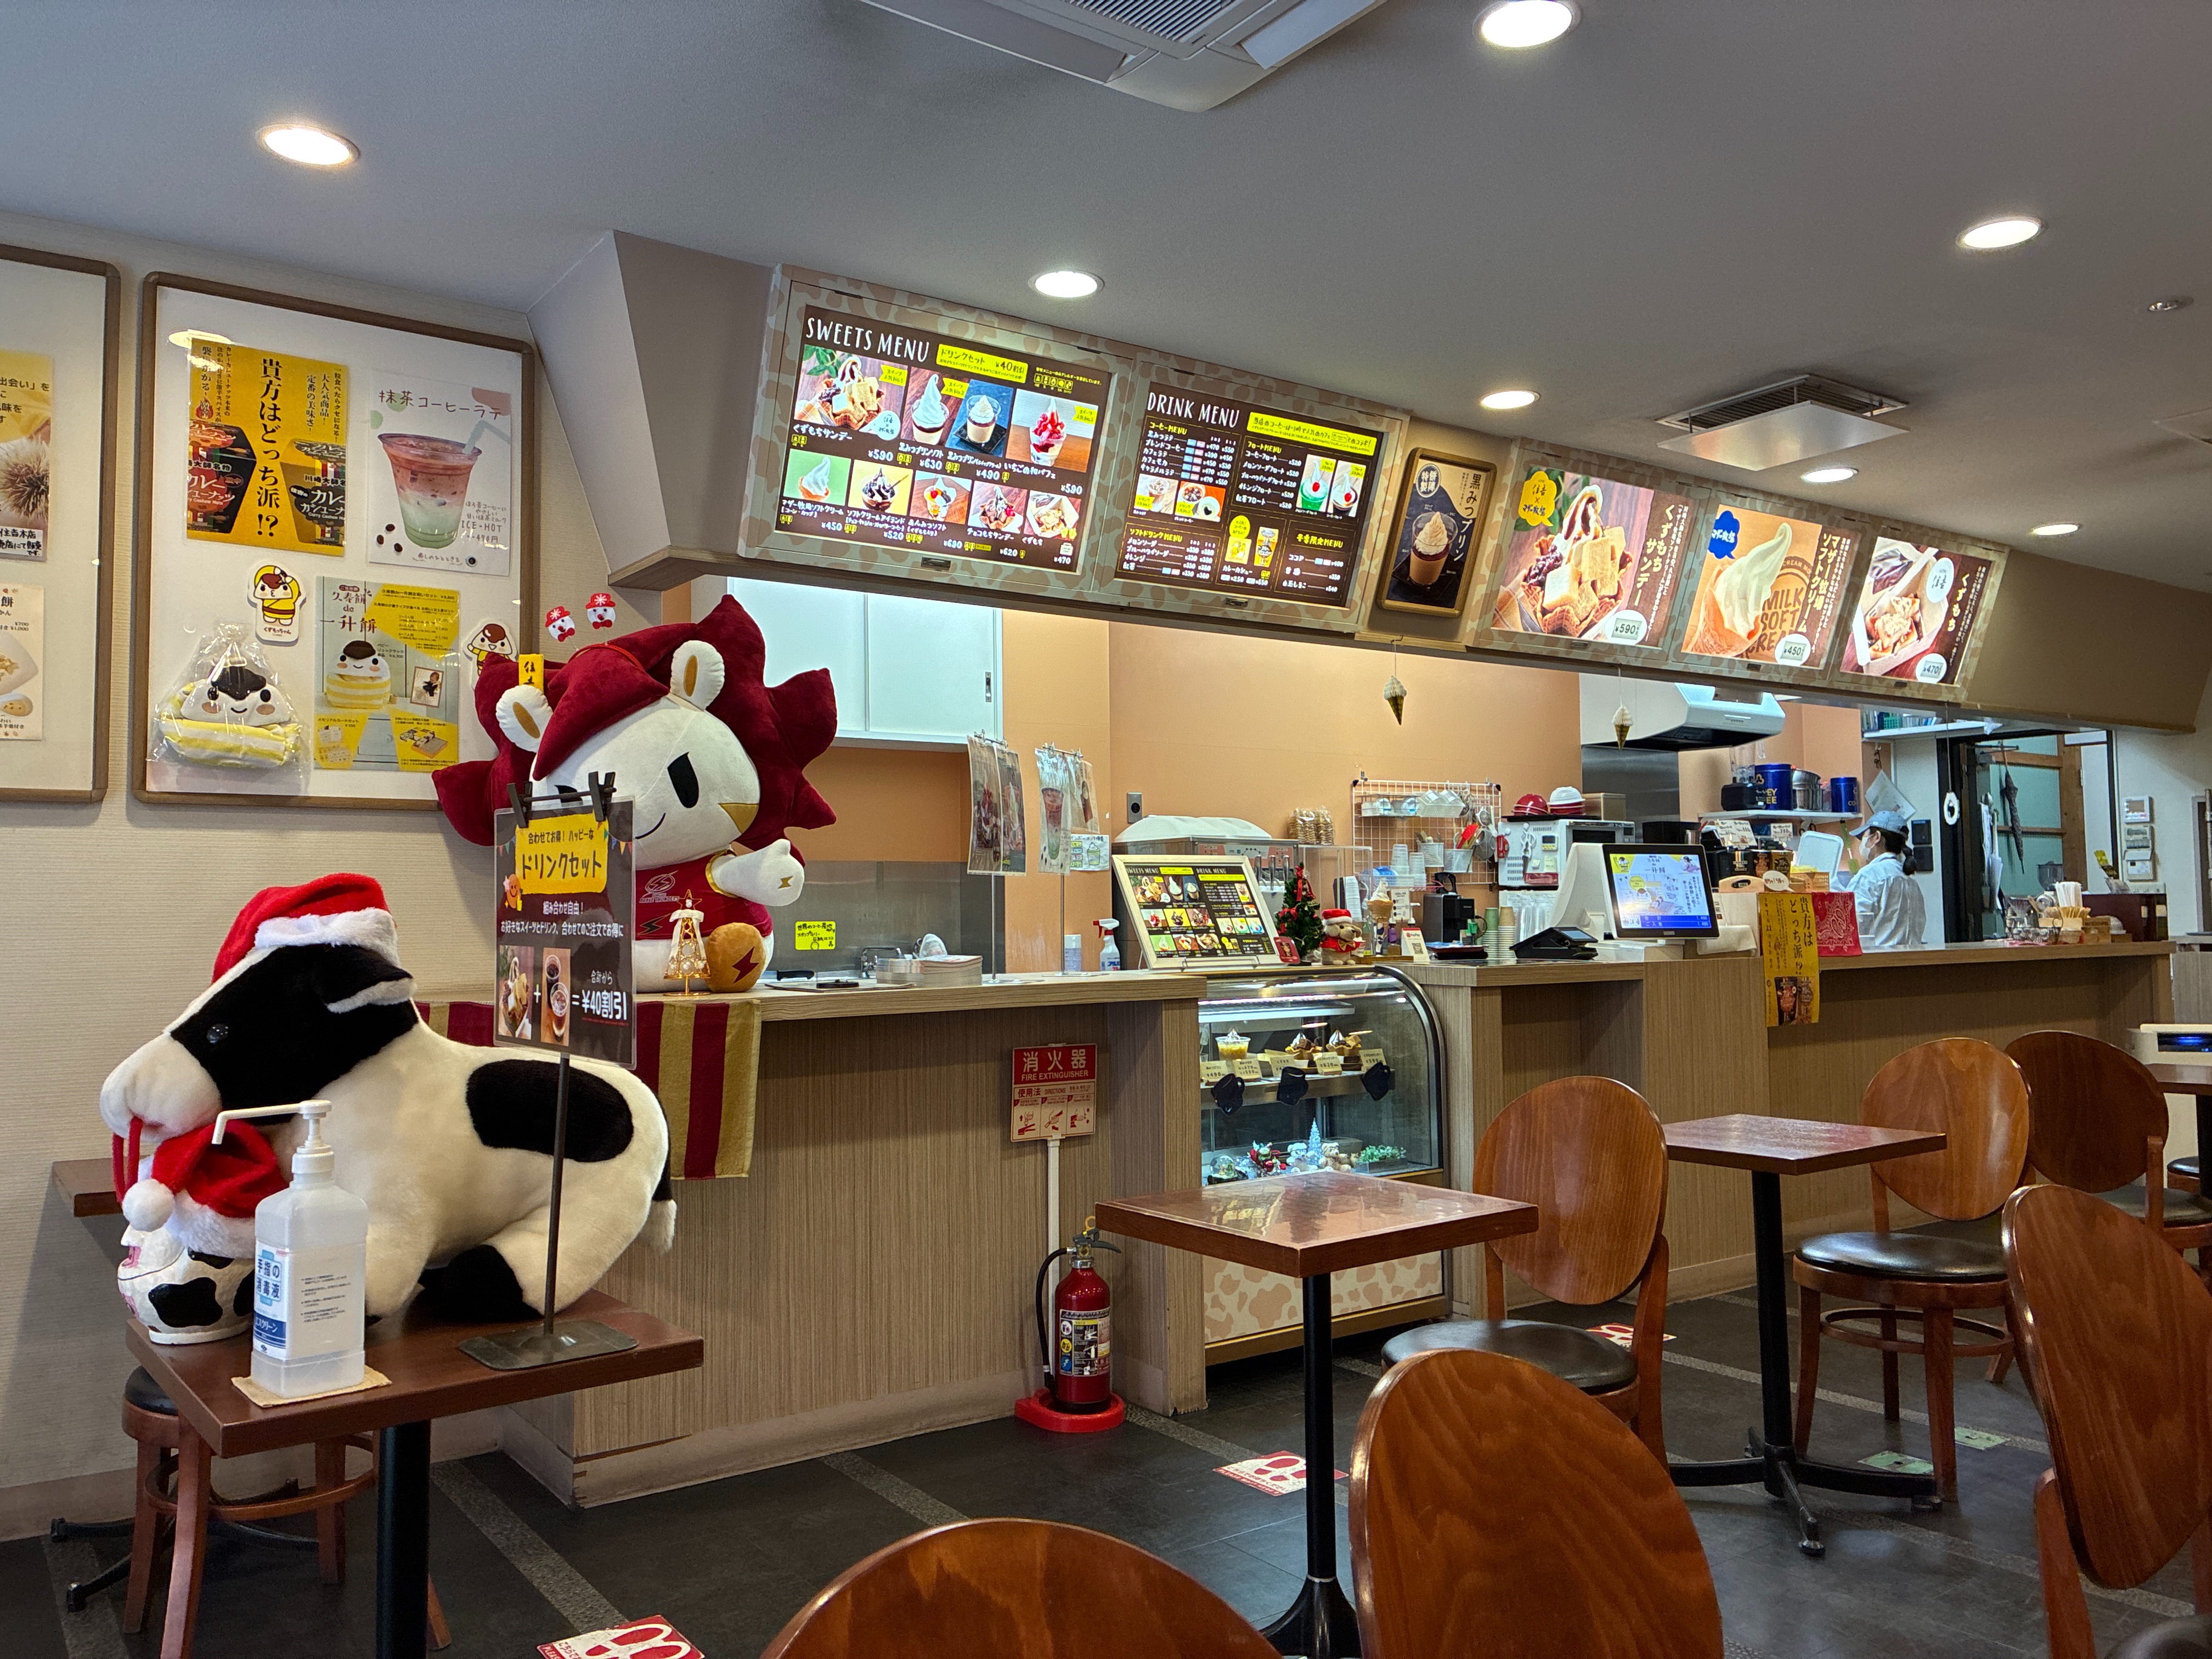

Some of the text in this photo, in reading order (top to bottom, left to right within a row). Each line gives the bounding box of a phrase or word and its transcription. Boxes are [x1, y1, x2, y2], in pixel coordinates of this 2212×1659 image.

[805, 317, 930, 363] SWEETS MENU
[941, 348, 1025, 375] ドリンクセット ¥40割引
[306, 374, 317, 435] 定番の美味さ!
[320, 374, 330, 426] 大人気商品!
[379, 389, 502, 420] 抹茶コーヒーラテ
[1147, 392, 1240, 428] DRINK MENU
[793, 424, 853, 441] くずもちサンデー
[1149, 421, 1188, 435] コーヒーMENU
[257, 358, 283, 537] 貴方はどっち派!?
[1143, 447, 1168, 458] カフェラテ
[1146, 439, 1185, 452] ブレンドコーヒー
[1248, 441, 1282, 454] フロートMENU
[868, 449, 893, 461] ¥590
[1142, 455, 1168, 466] カフェモカ
[1245, 450, 1277, 462] コーヒーフロート
[919, 458, 943, 470] ¥630
[1004, 462, 1056, 479] いちごの和パフェ
[1140, 464, 1175, 476] キャラメルラテ
[1243, 460, 1284, 475] メロンソーダフロート
[977, 469, 1000, 481] ¥490
[1060, 483, 1083, 494] ¥590
[1239, 483, 1272, 494] オレンジフロート
[1235, 494, 1266, 505] 紅茶フロート
[782, 499, 844, 515] マザー牧場ソフトクリーム
[847, 510, 905, 524] ソフトクリームアイランド
[1453, 473, 1482, 562] 黒みつプリン
[821, 521, 843, 532] ¥450
[908, 518, 947, 532] あんみつソフト
[884, 531, 904, 540] ¥520
[967, 527, 1014, 540] チョコもちサンデー
[1130, 528, 1182, 543] ソフトドリンクMENU
[1652, 504, 1675, 573] くずもち
[1022, 536, 1043, 546] くずもち
[1127, 537, 1158, 547] メロンソーダ
[1000, 548, 1018, 557] ¥620
[1125, 553, 1147, 562] オレンジ
[1126, 545, 1170, 557] ブルーハワイソーダ
[1054, 556, 1072, 565] ¥470
[1122, 561, 1136, 571] 紅茶
[1222, 565, 1253, 575] カレーカシュー
[1634, 538, 1658, 606] サンデー
[1814, 535, 1841, 611] マザー牧場
[1797, 533, 1832, 633] ソフトクリーム
[332, 591, 366, 604] 久寿餅
[1763, 586, 1805, 612] MILK
[1948, 573, 1970, 632] くずもち
[343, 604, 354, 612] de
[320, 614, 377, 634] 一升餅
[1760, 608, 1800, 631] SOFT
[1615, 623, 1636, 635] ¥590
[1784, 643, 1801, 656] ¥450
[1923, 664, 1939, 674] ¥470
[528, 827, 594, 844] 合わせてお得! ハッピーな
[522, 850, 602, 880] ドリンクセット
[543, 900, 584, 915] 組み合わせ自由!
[1800, 896, 1814, 947] 貴方は
[501, 920, 624, 938] お好きなスイーツとドリンク、合わせてのご注文でお得に
[1789, 899, 1803, 975] どっち派!?
[1023, 1049, 1087, 1073] 消火器
[1039, 1070, 1089, 1080] EXTINGUISHER
[1018, 1087, 1041, 1098] 使用法
